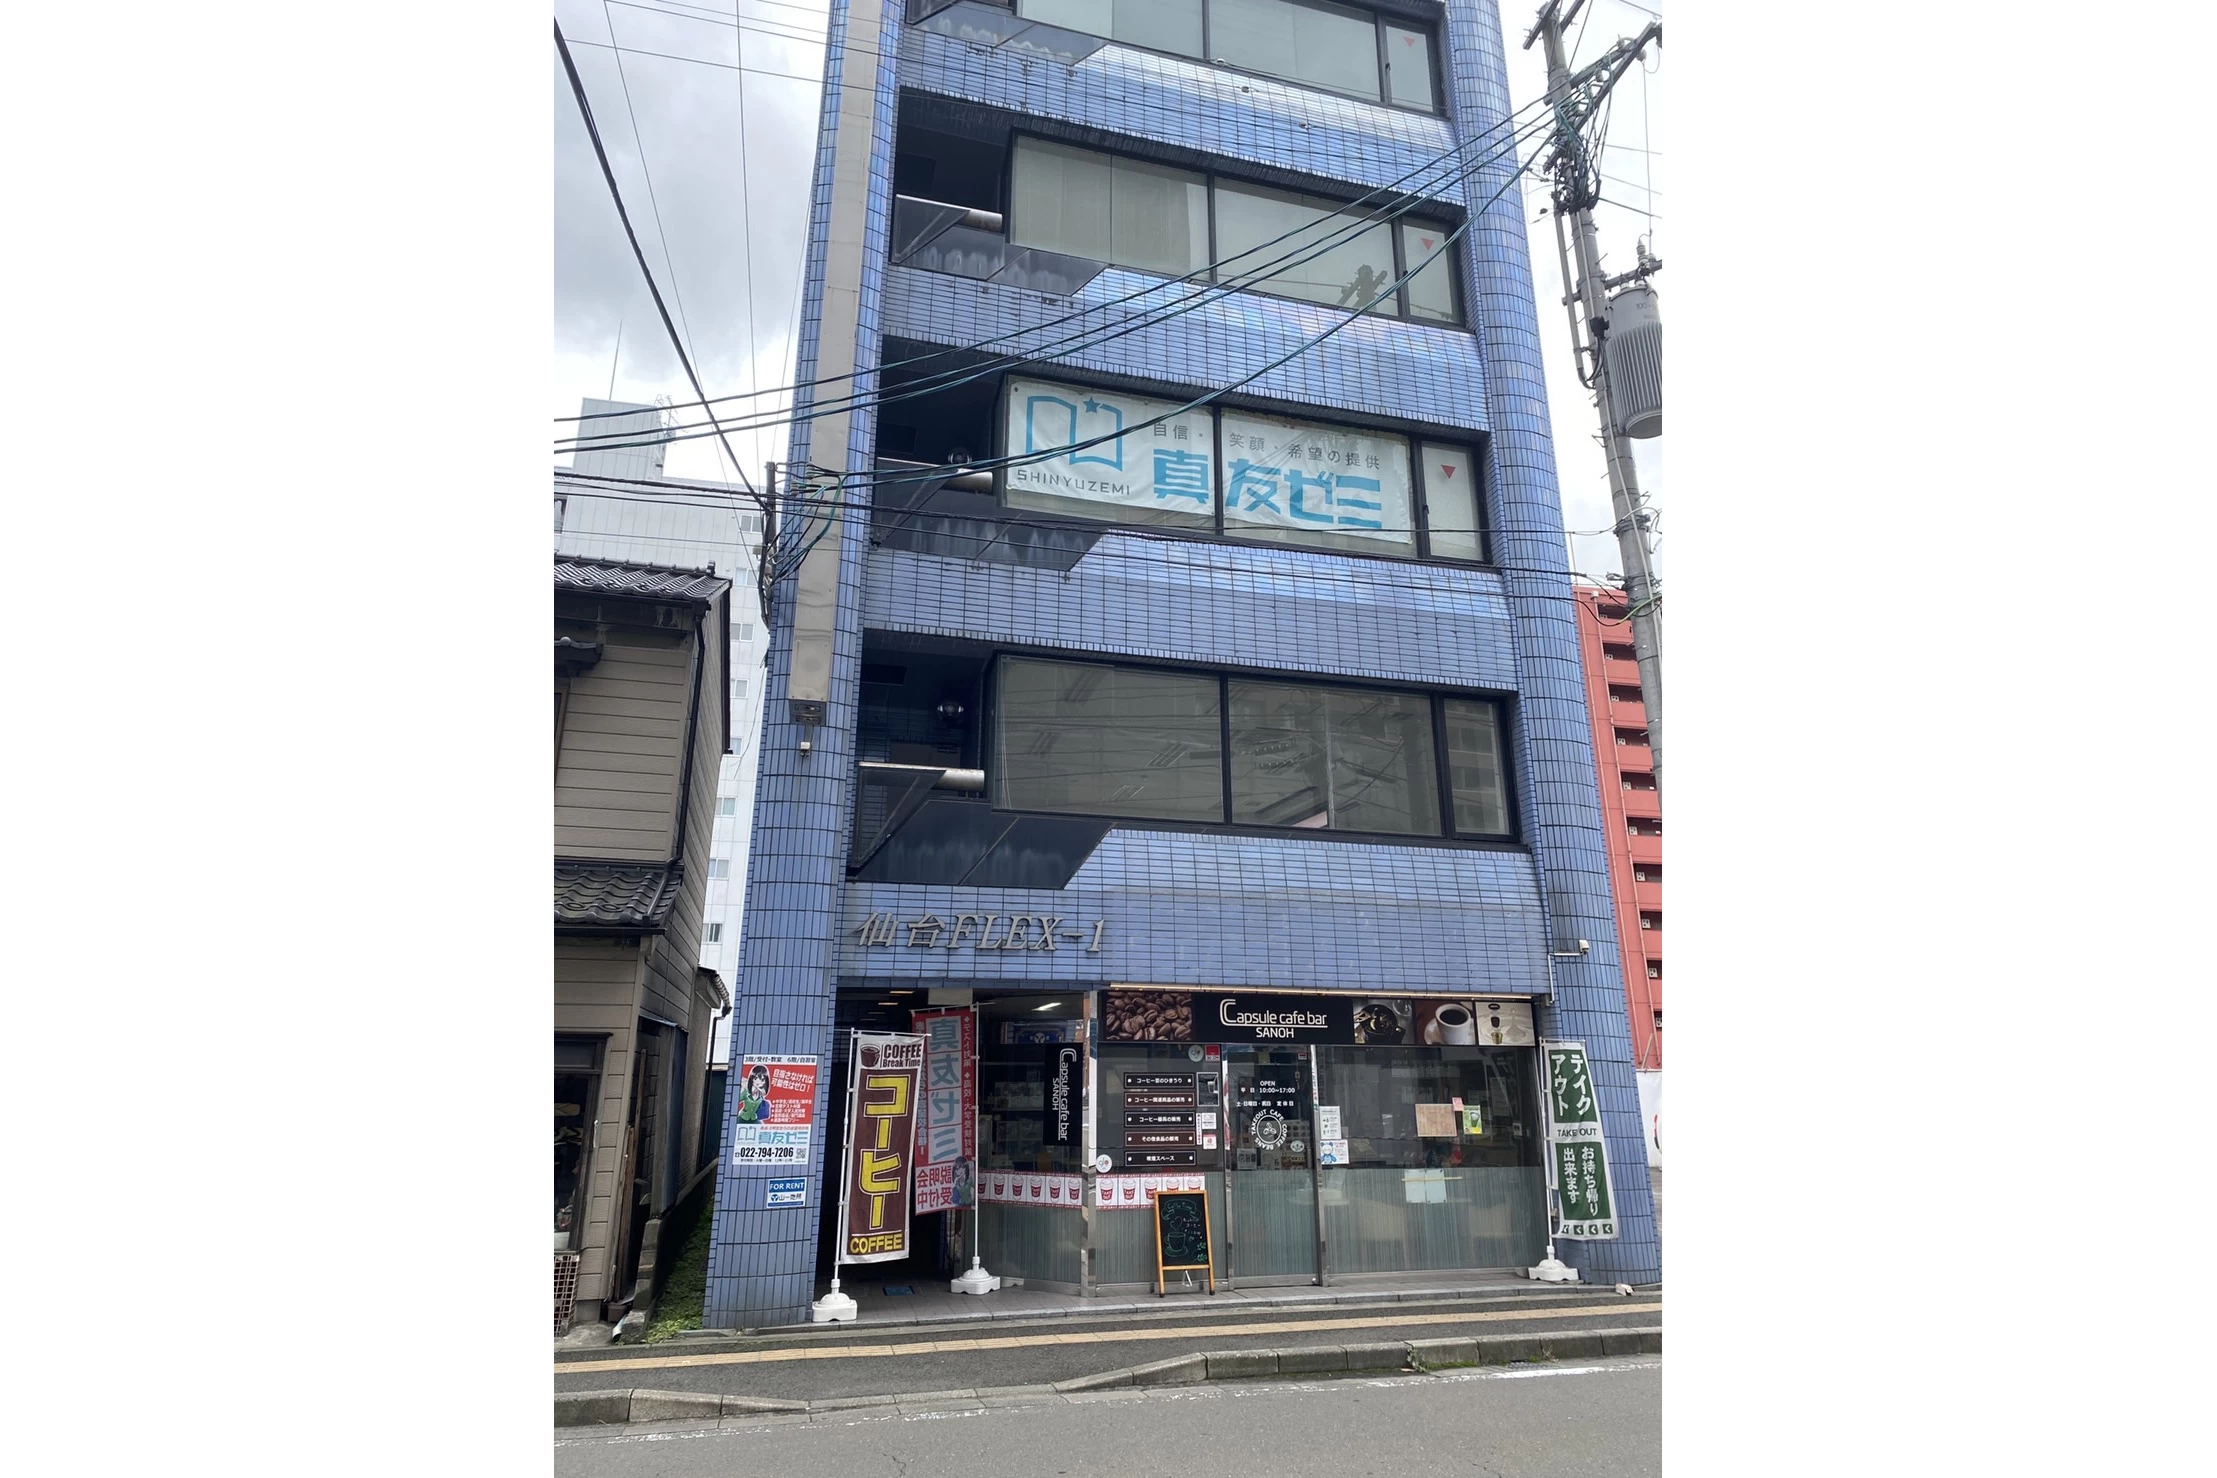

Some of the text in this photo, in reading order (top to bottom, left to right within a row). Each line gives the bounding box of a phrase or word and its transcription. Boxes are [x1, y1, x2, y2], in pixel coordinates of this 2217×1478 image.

[1017, 469, 1131, 496] SHINYUZEMI
[1153, 448, 1383, 529] 真友ゼミ
[1220, 998, 1327, 1026] Capsule cafe bar
[1256, 1027, 1294, 1039] SANOH
[883, 1058, 921, 1068] Break Time
[884, 1044, 922, 1059] COFFEE
[1052, 1077, 1060, 1111] SANOH
[1060, 1048, 1077, 1141] Capsule cafe bar
[1550, 1054, 1569, 1117] アウト
[1570, 1054, 1592, 1116] テイク
[1251, 1109, 1267, 1135] TAKEOUT
[1269, 1109, 1285, 1121] CAFE
[1557, 1128, 1597, 1137] TAKE OUT
[758, 1131, 809, 1145] 真友ゼミ
[859, 1073, 912, 1230] コーヒー
[740, 1147, 794, 1158] 022-794-7206
[786, 1182, 804, 1190] RENT
[1563, 1147, 1580, 1204] 出来ます
[1581, 1146, 1599, 1217] お持ち帰り
[850, 1233, 902, 1254] COFFEE
